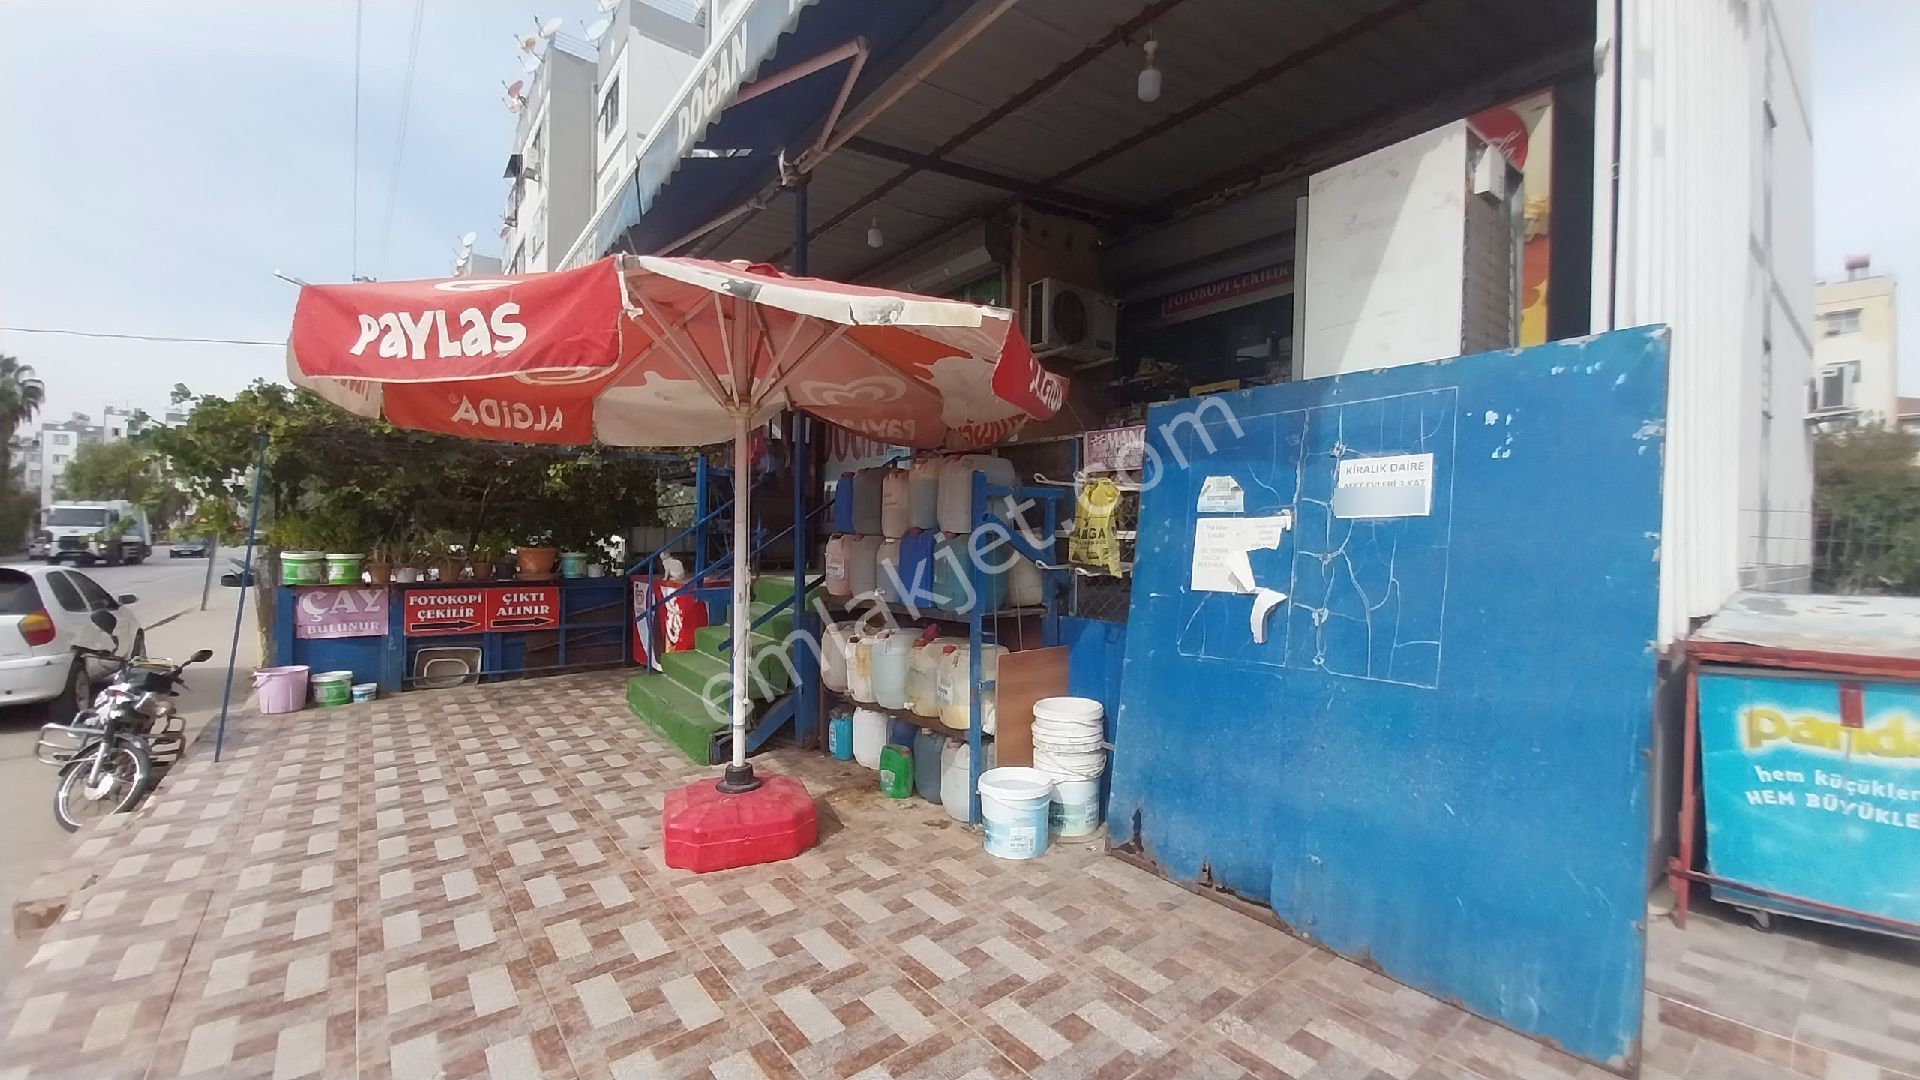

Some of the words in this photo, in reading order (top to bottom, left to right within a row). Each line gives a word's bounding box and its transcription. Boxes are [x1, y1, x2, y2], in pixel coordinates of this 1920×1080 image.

[298, 589, 385, 622] ÇAY
[409, 592, 482, 607] FOTOKOPİ
[502, 592, 545, 604] ÇIKTI
[417, 607, 475, 622] ÇEKİLİR
[496, 604, 550, 617] ALINIR
[307, 621, 380, 635] BULUNUR
[1753, 764, 1806, 783] hem
[1744, 789, 1796, 806] HEM
